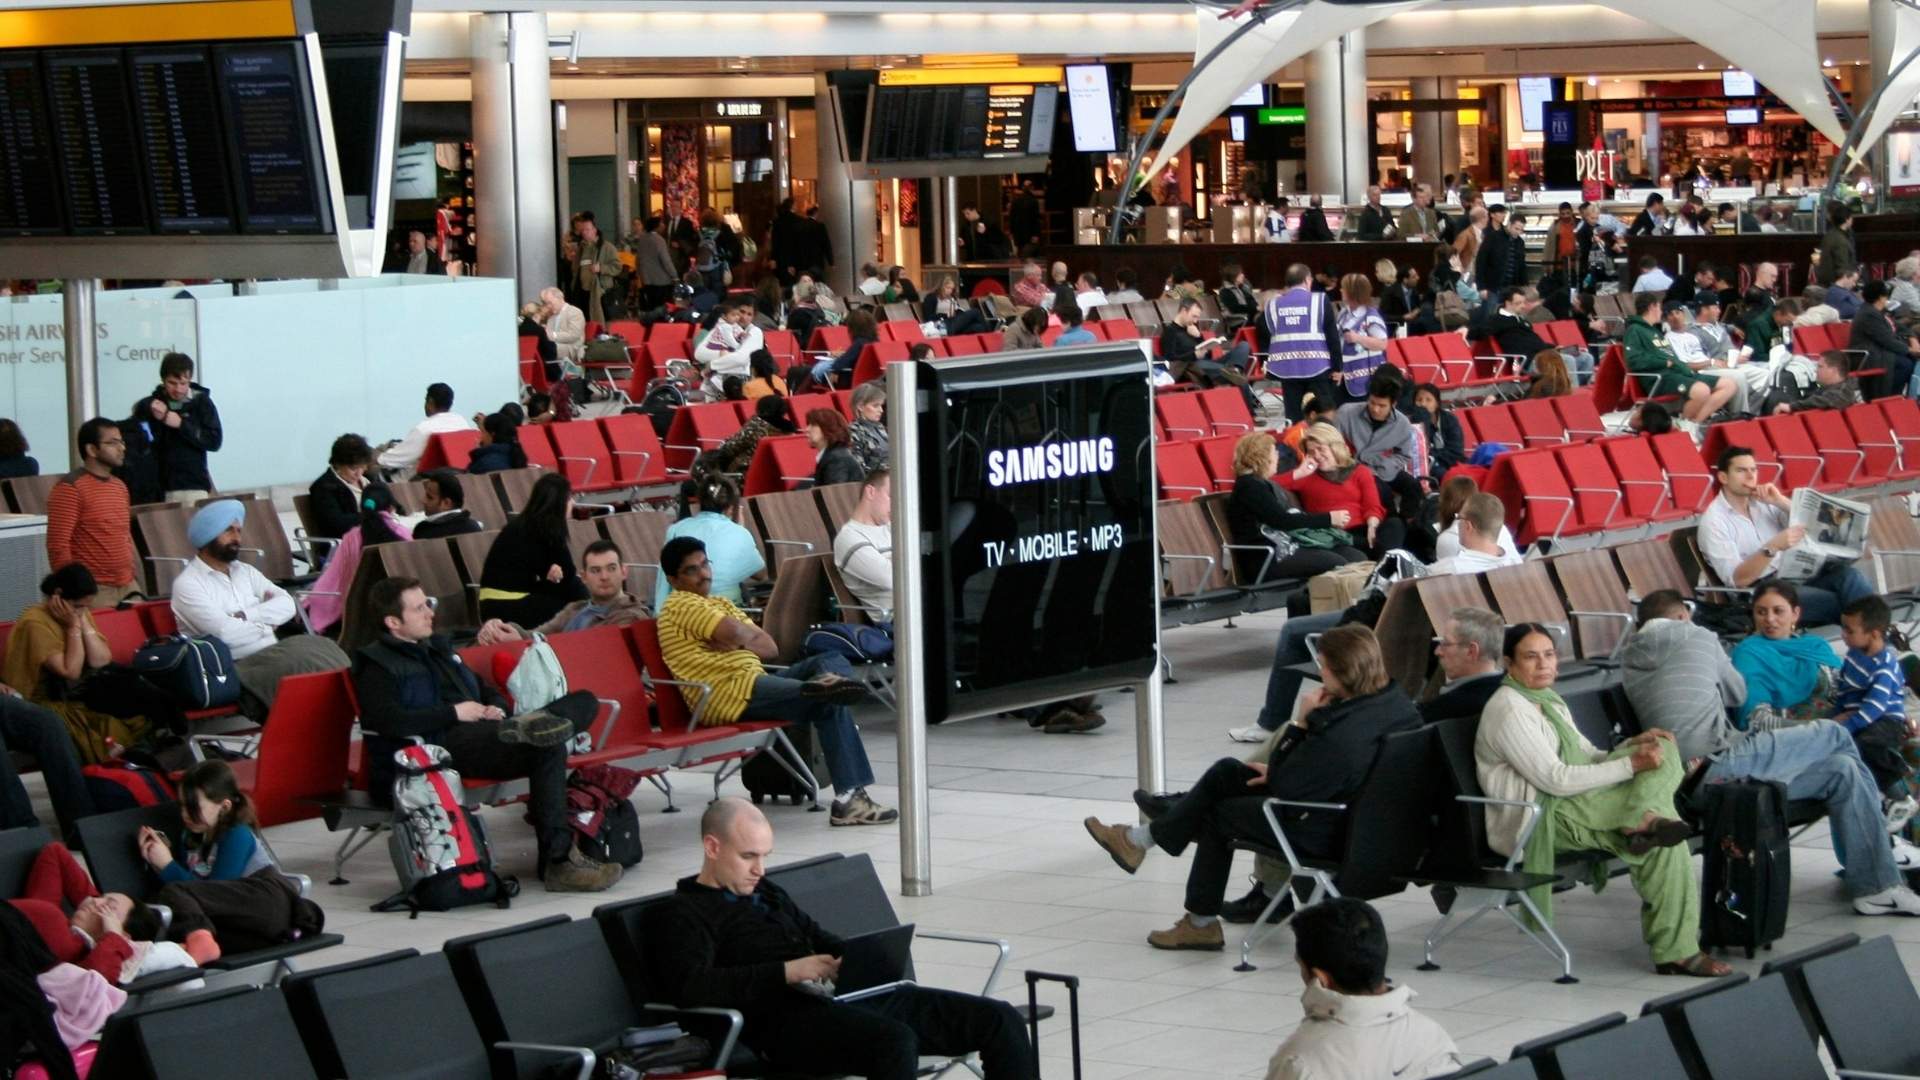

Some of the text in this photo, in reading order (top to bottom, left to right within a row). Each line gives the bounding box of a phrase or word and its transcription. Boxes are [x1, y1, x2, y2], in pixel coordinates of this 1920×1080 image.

[1576, 149, 1616, 182] PRET
[1278, 306, 1308, 316] CUSTOMER
[26, 322, 109, 340] AIRS
[988, 437, 1114, 486] SAMSUNG
[984, 523, 1123, 567] TV MOBILE MP3
